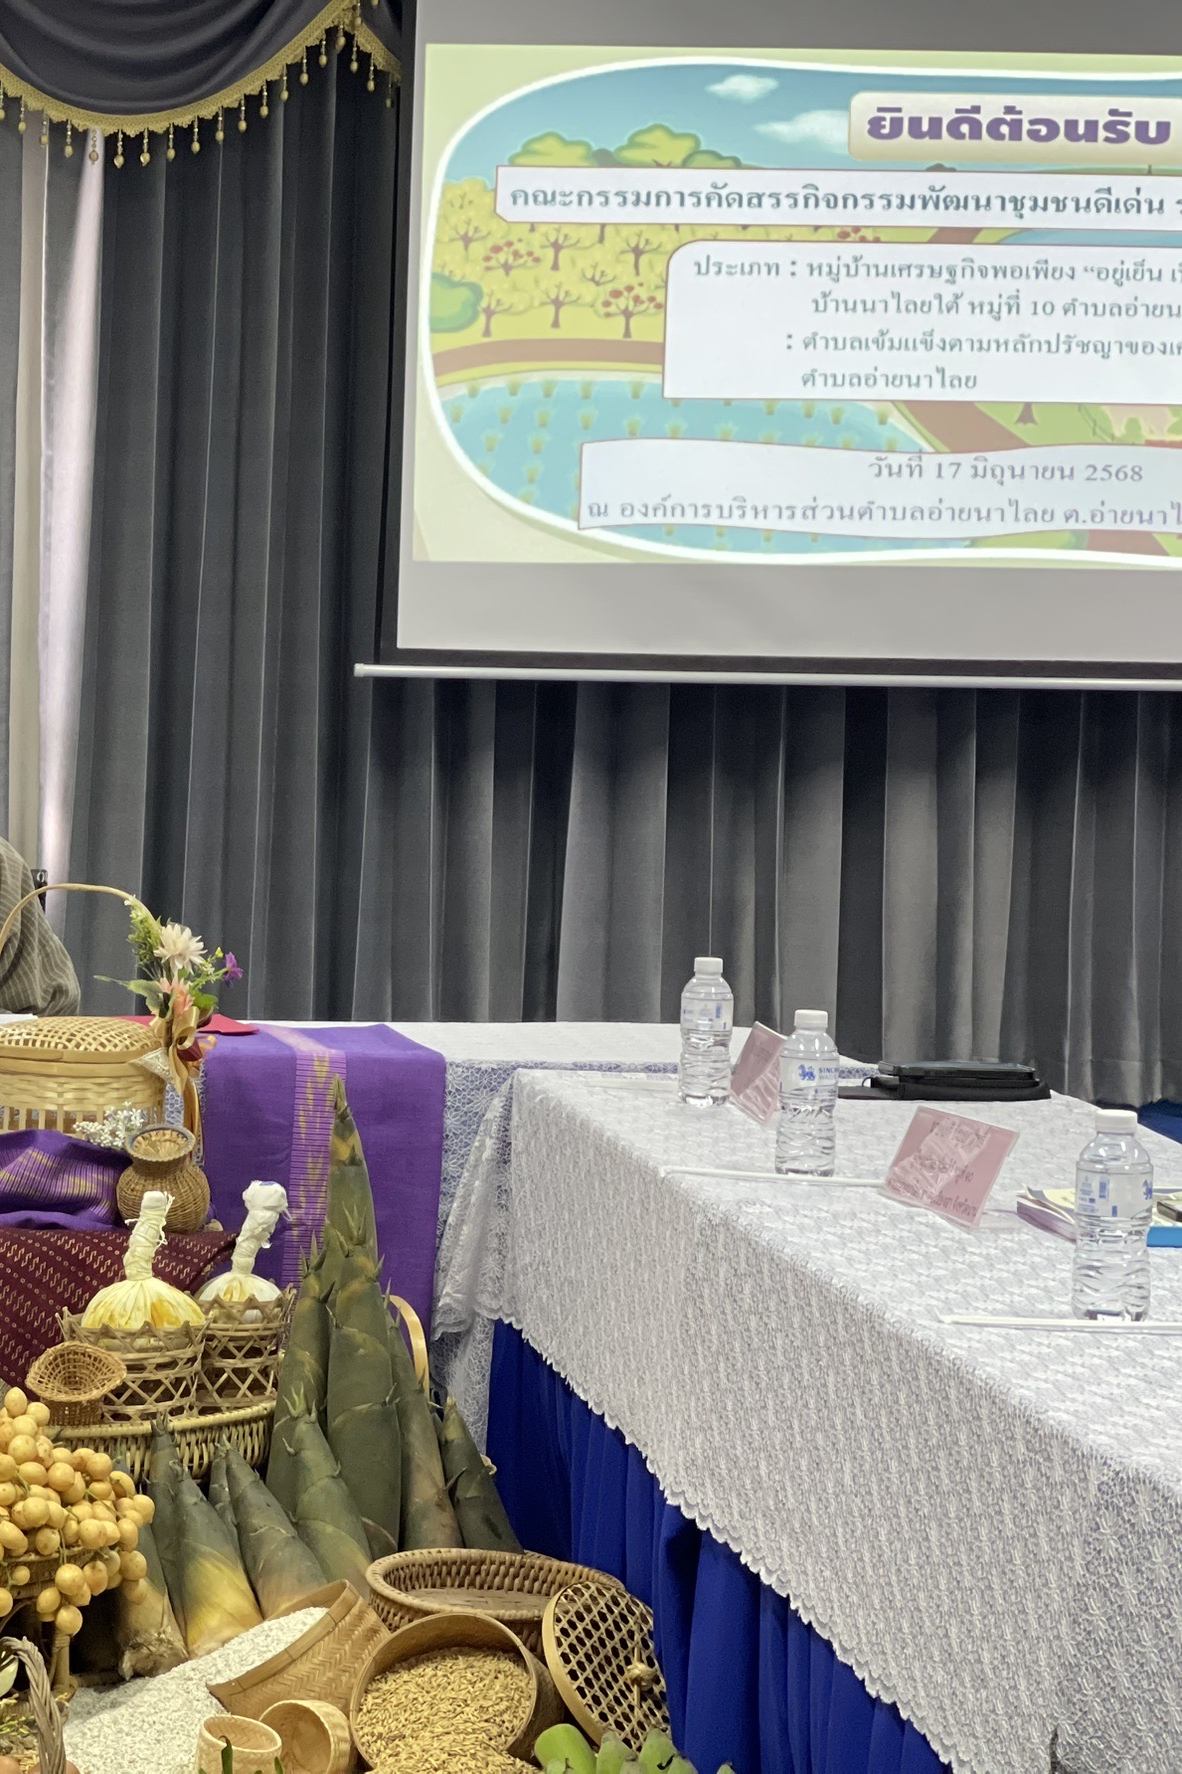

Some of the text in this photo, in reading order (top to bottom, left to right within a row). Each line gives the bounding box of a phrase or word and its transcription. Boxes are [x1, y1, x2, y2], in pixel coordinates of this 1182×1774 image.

[867, 105, 1171, 145] ยินดีต้อนรับ
[511, 182, 1164, 220] คณะกรรมการคัดสรรกิจกรรมพัฒนาชุมชนดีเด่น
[694, 254, 780, 277] ประเภท
[807, 254, 1075, 285] หมู่บ้านเศรษฐกิจพอเพียง
[811, 290, 964, 315] บ้านนาไลยใต้
[968, 288, 1021, 321] หมู่ที่
[1030, 300, 1055, 316] 10
[801, 366, 978, 389] ตำบลอ่ายนาไลย
[868, 450, 1144, 486] วันที่ 17 มิถุนายน 2568
[588, 501, 609, 517] ณ
[620, 494, 1055, 523] องค์การบริหารส่วนตำบลอ่ายนาไลย
